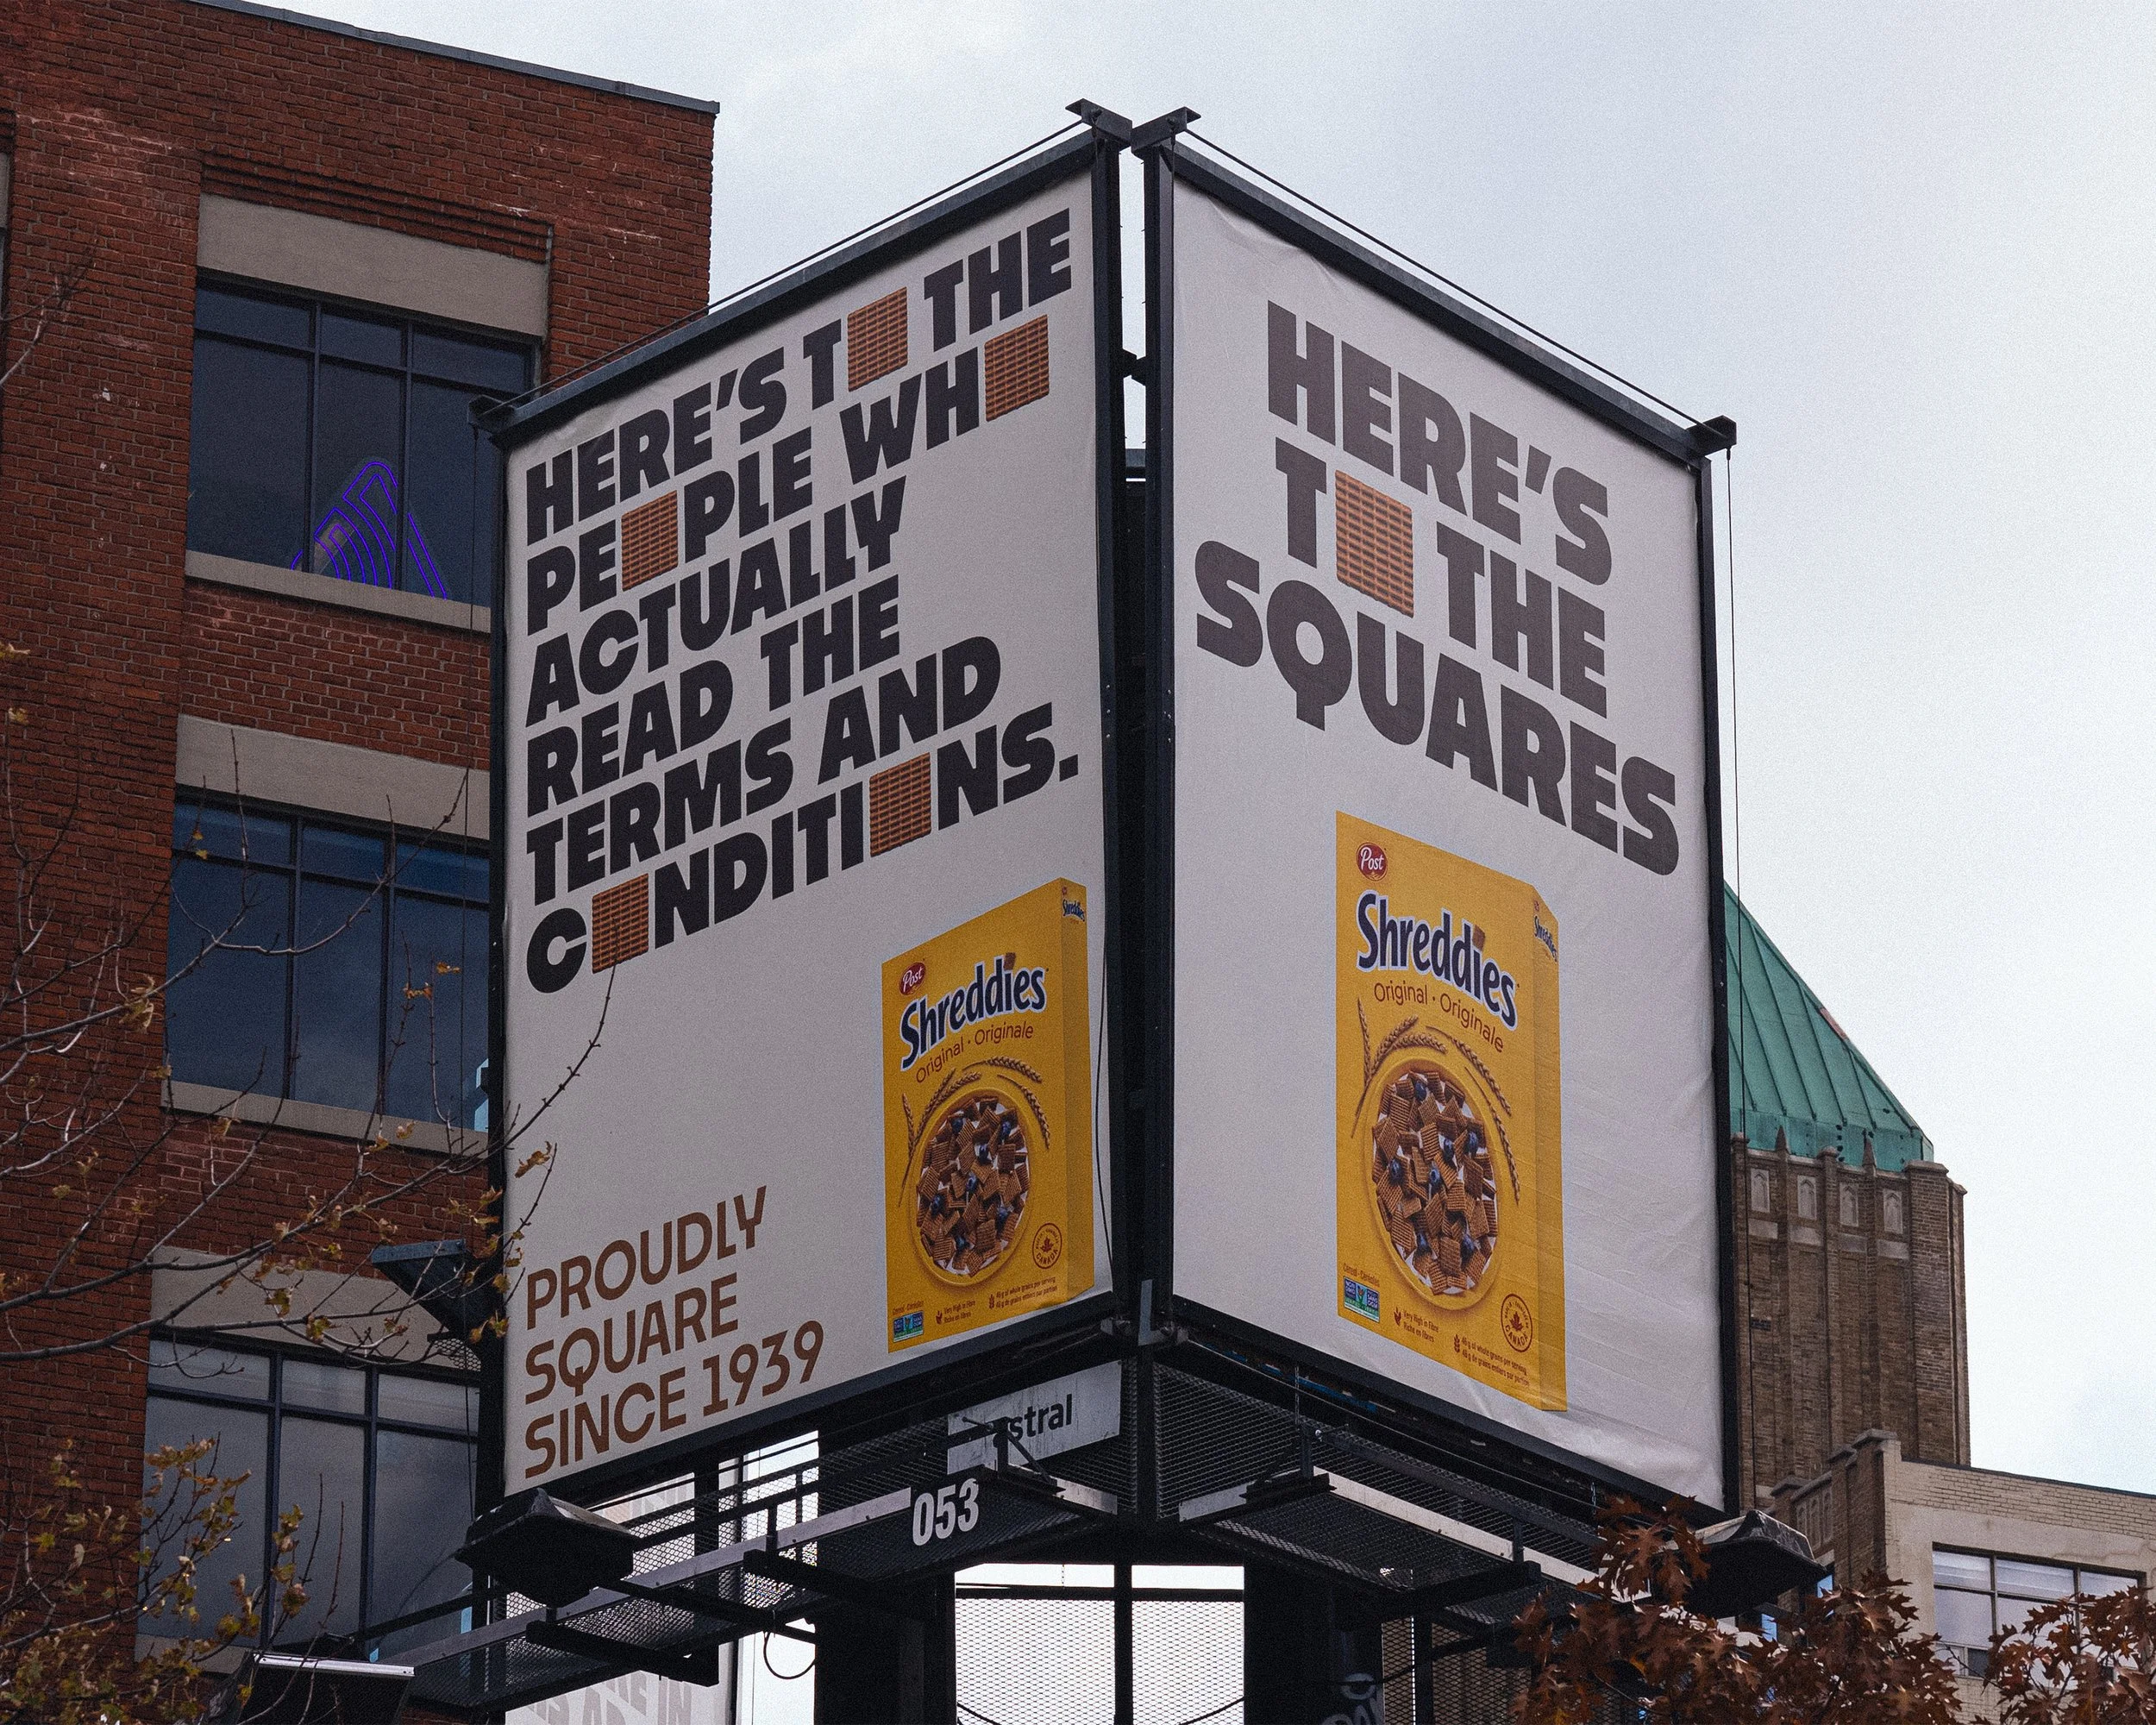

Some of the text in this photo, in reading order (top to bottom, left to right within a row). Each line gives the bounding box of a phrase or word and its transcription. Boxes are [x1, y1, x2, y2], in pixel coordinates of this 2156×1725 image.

[527, 348, 787, 545] HERE'S
[924, 209, 1072, 352] THE
[1268, 300, 1612, 586] HERE'S
[526, 475, 906, 727] ACTUALLY
[527, 427, 813, 636] PEPLE
[1437, 521, 1607, 718] THE
[526, 637, 1000, 906] TERMS AND
[527, 574, 899, 818] READ THE
[1194, 541, 1679, 875] SQUARES
[526, 702, 1079, 993] CNDITINS.
[1360, 847, 1384, 870] Post
[900, 952, 1047, 1071] Shreddies
[902, 966, 924, 992] Post
[1357, 890, 1517, 1031] Shreddies
[1374, 980, 1504, 1052] Original Originale
[916, 1021, 1033, 1082] Original Originale
[527, 1185, 767, 1330] PROUDLY
[525, 1273, 738, 1404] SQUARE
[525, 1320, 824, 1478] SINCE 1939
[993, 1394, 1072, 1449] stral
[912, 1477, 979, 1546] 053
